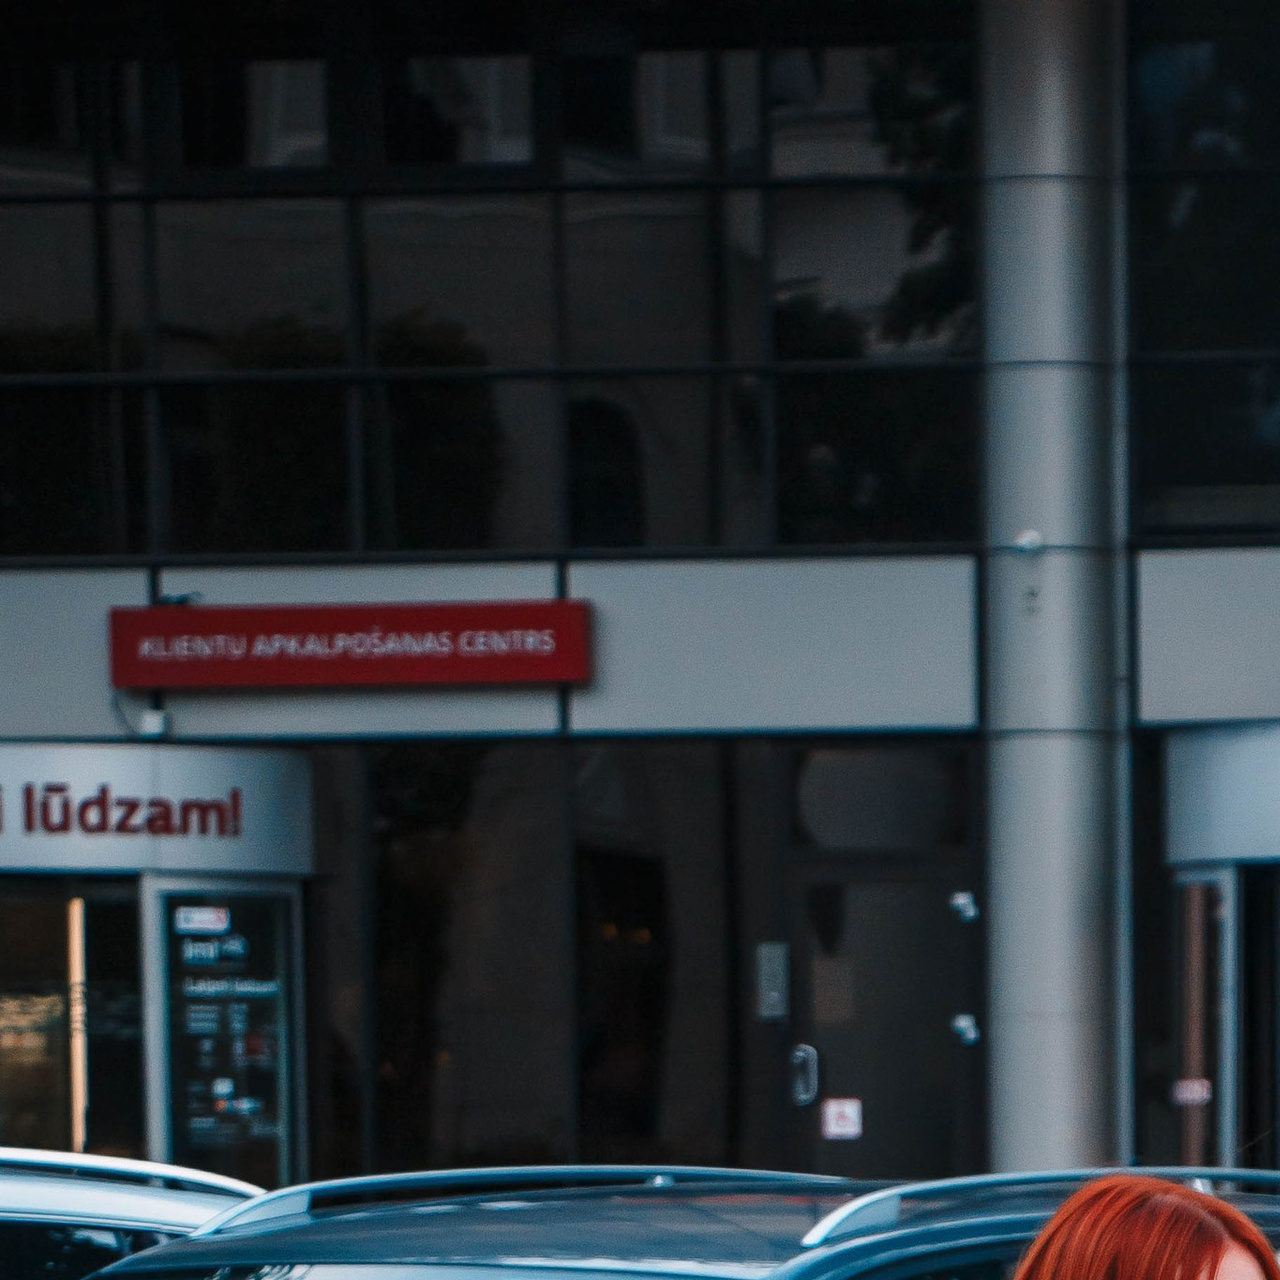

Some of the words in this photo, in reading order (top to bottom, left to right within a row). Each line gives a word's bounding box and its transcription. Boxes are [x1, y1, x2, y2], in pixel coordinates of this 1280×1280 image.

[138, 634, 247, 660] KLIENTU
[251, 626, 454, 660] APKALPOŠANAS
[458, 629, 556, 657] CENTRS
[23, 782, 242, 837] lūdzam!
